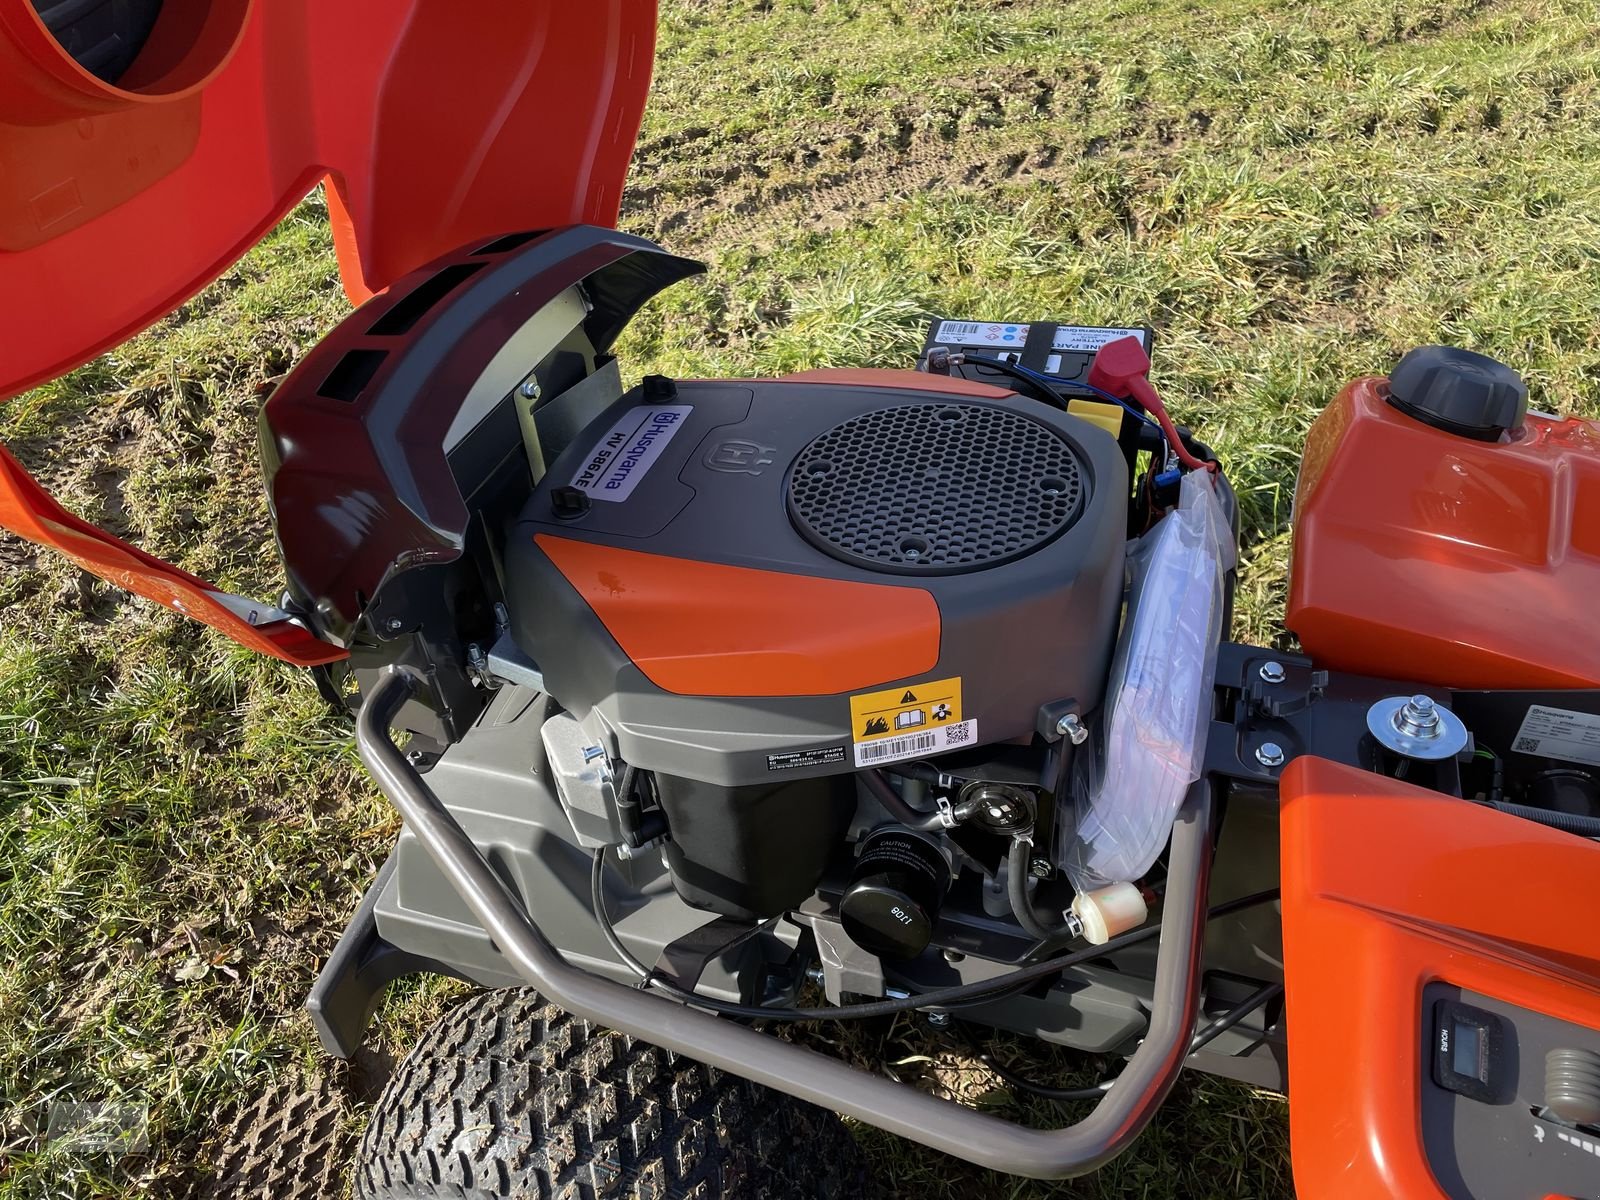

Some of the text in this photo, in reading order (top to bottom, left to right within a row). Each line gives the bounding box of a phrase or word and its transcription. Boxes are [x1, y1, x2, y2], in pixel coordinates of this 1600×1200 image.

[575, 432, 626, 488] HV 586AE
[605, 424, 668, 489] Husqvarna
[880, 840, 911, 849] CAUTION
